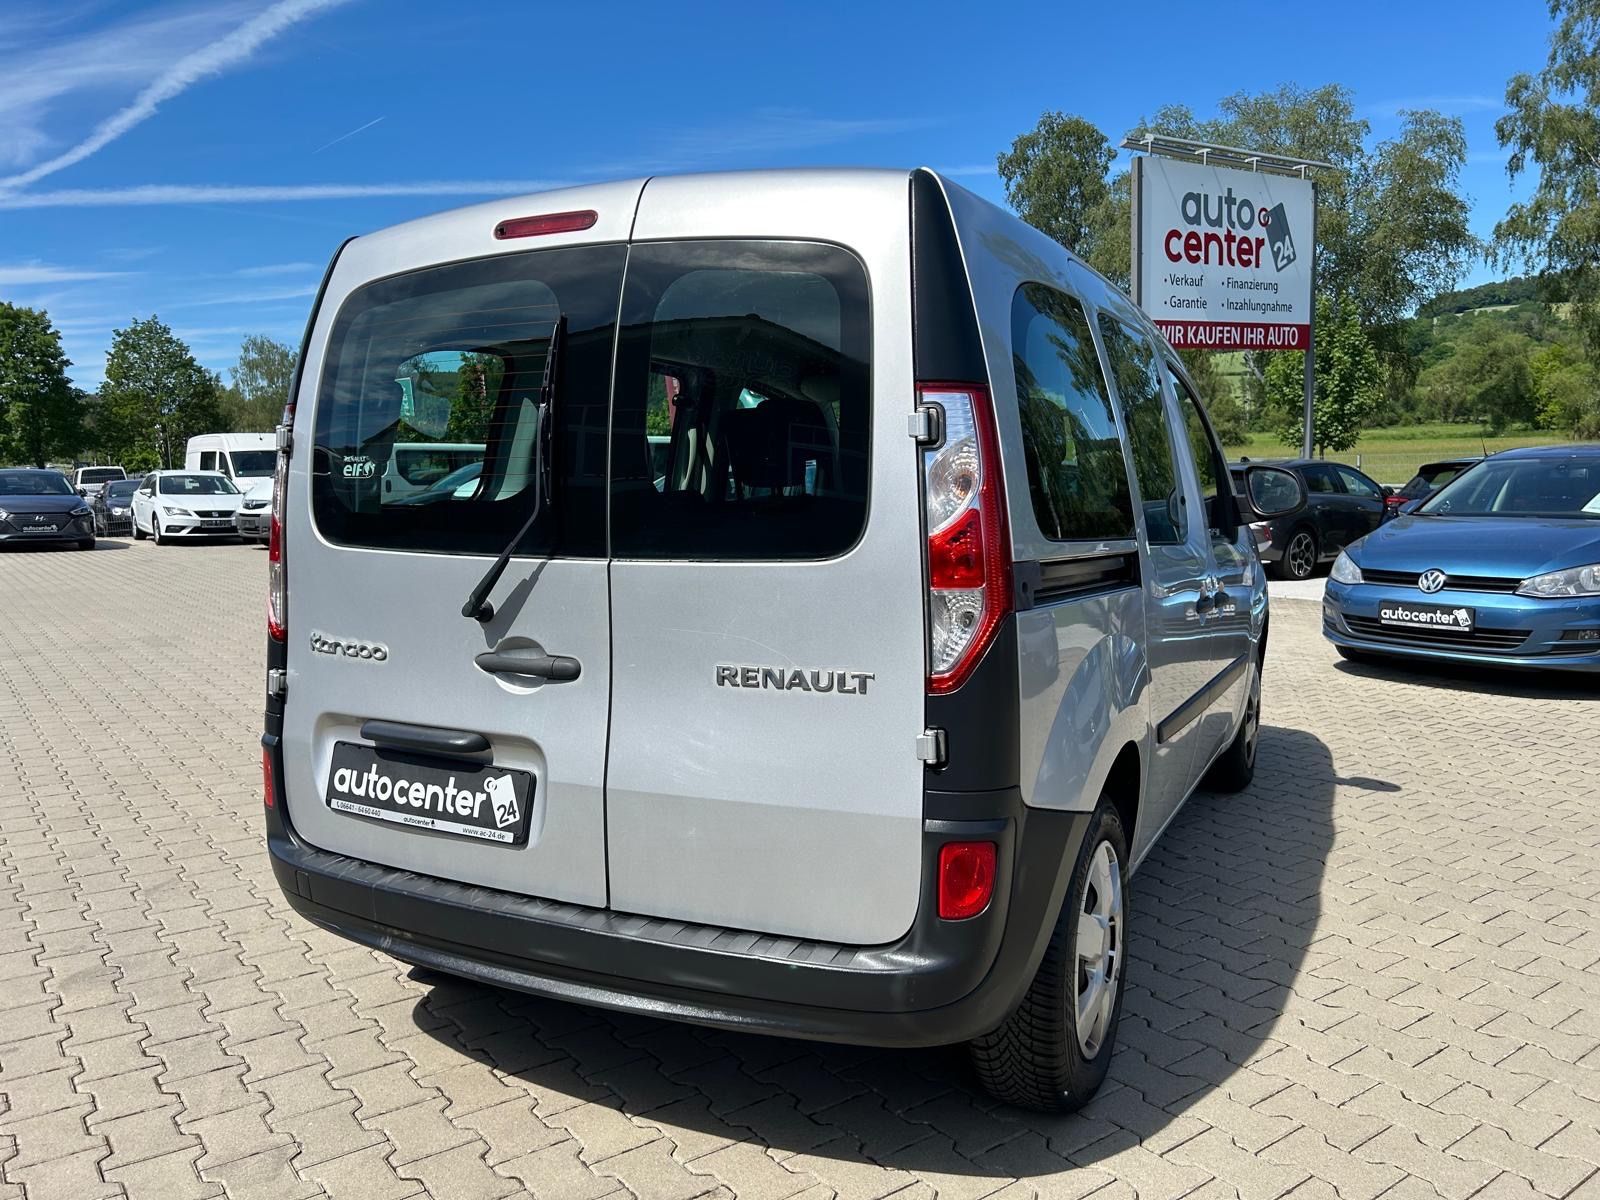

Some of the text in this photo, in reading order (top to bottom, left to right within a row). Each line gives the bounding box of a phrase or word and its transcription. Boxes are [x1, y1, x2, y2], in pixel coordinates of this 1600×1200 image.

[1181, 187, 1255, 231] auto
[1164, 228, 1294, 269] center 24
[1169, 273, 1204, 287] Verkauf
[1226, 277, 1278, 294] Finanzierung
[1169, 295, 1208, 310] Garantie
[1226, 298, 1293, 315] Inzahlungnahme
[1187, 325, 1240, 345] KAUFEN
[1243, 327, 1265, 345] IHR
[1266, 326, 1299, 346] AUTO
[716, 664, 876, 695] RENAULT
[333, 763, 517, 825] autocenter 24
